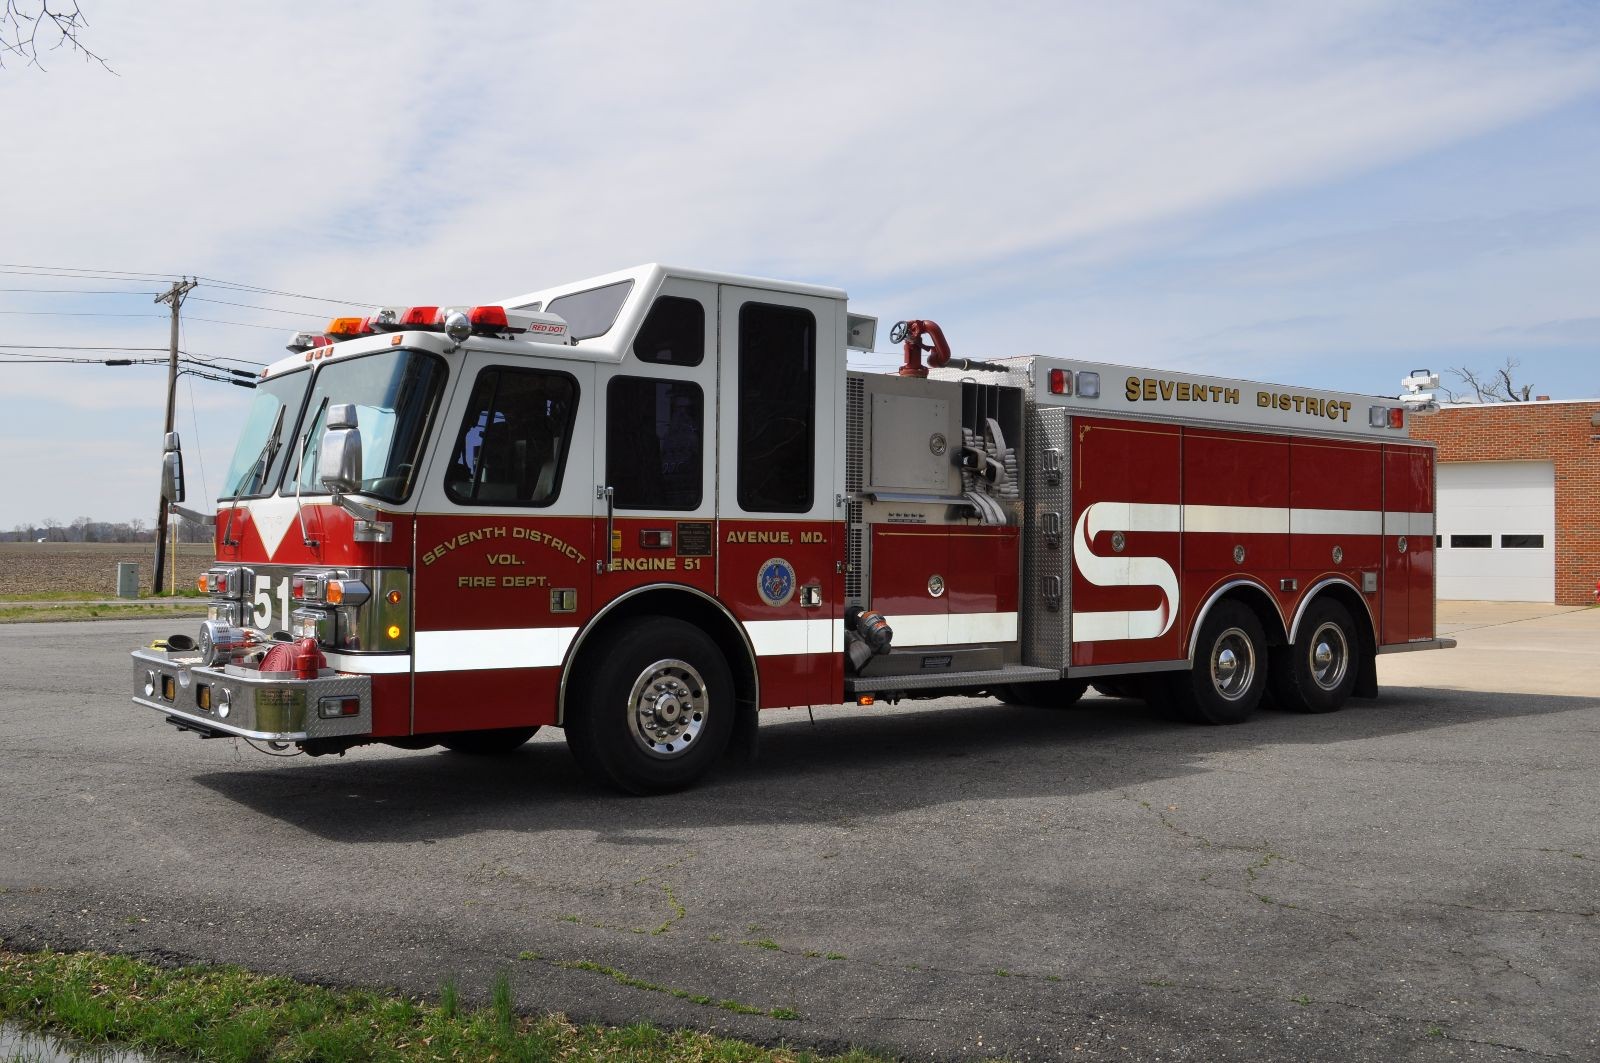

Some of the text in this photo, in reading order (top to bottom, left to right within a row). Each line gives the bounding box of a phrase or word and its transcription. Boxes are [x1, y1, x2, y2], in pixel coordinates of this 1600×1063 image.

[548, 325, 564, 333] DOT
[1125, 376, 1352, 422] SEVENTH DISTRICT
[726, 531, 828, 545] AVENUE, MD.
[422, 526, 506, 566] SEVENTH
[512, 526, 587, 565] DISTRICT
[486, 553, 526, 565] VOL.
[611, 557, 701, 571] ENGINE 51
[458, 576, 551, 588] FIRE DEPT.
[253, 575, 289, 631] 51
